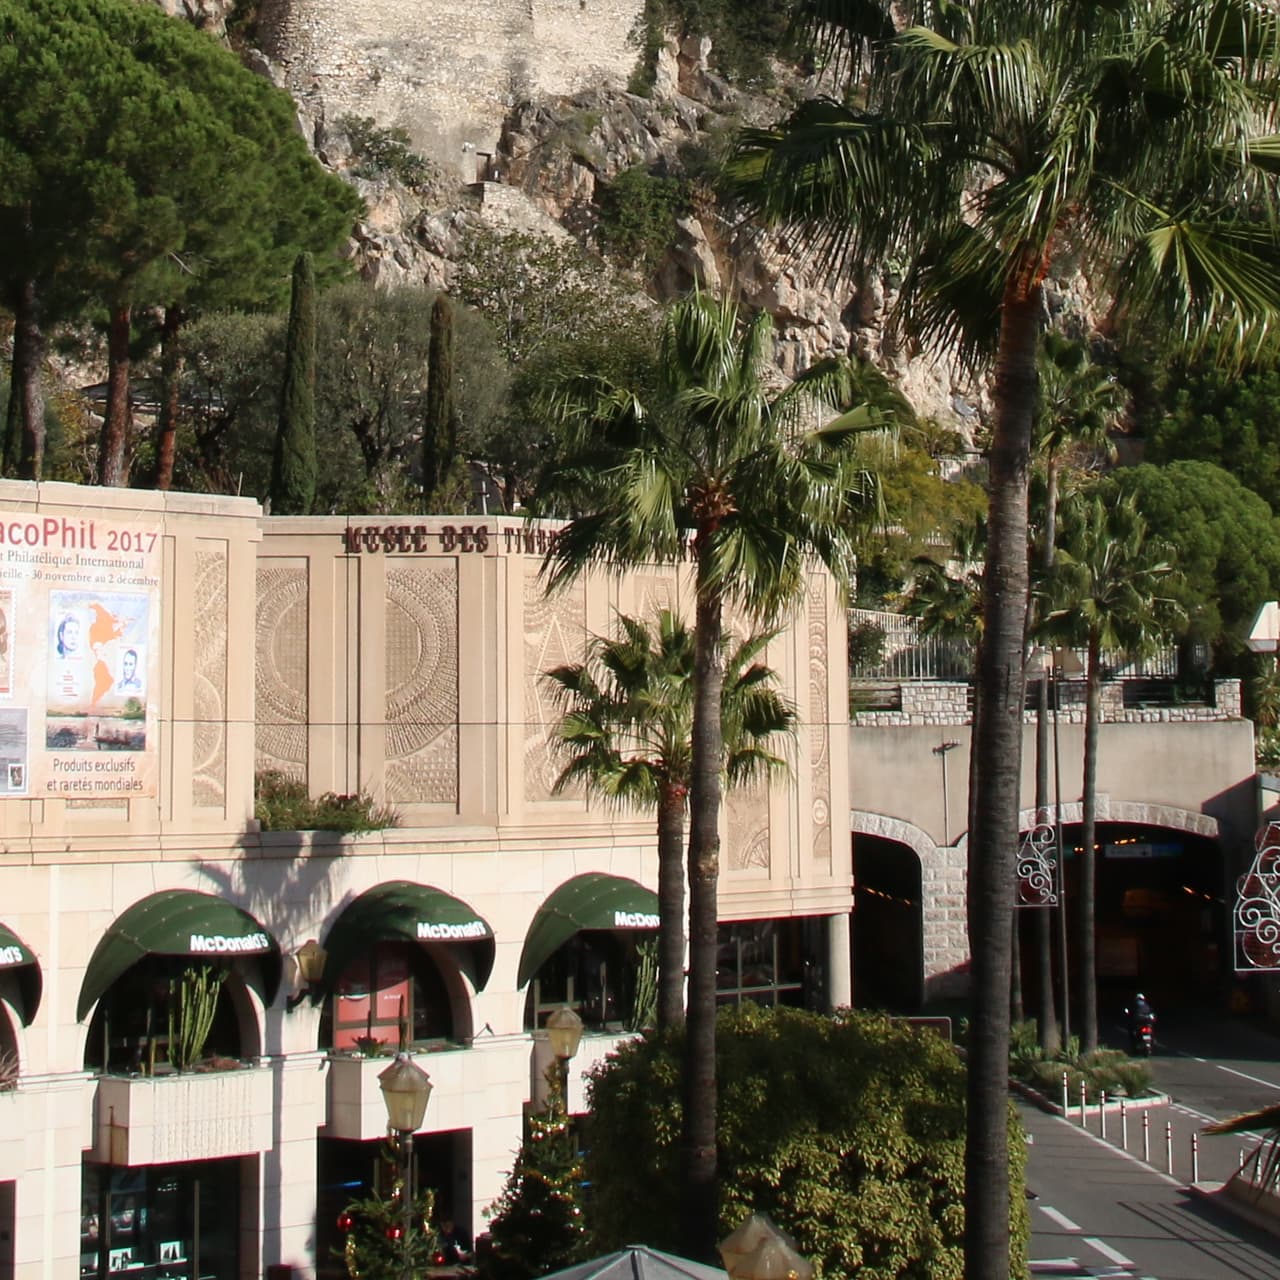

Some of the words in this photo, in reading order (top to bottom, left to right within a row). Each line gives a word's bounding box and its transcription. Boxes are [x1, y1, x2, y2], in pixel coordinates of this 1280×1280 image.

[107, 530, 158, 553] 2017
[343, 525, 428, 554] MUSEE
[440, 525, 489, 553] DES
[8, 549, 72, 567] Philatélique
[75, 553, 144, 569] International
[32, 569, 42, 580] 30
[45, 571, 91, 583] novembre
[94, 575, 106, 584] au
[108, 573, 115, 584] 2
[53, 758, 92, 772] Produits
[94, 757, 136, 772] exclusifs
[47, 779, 57, 791] et
[60, 777, 93, 792] raretés
[94, 777, 144, 791] mondiales
[417, 921, 487, 938] McDonald's
[190, 933, 269, 952] McDonald's
